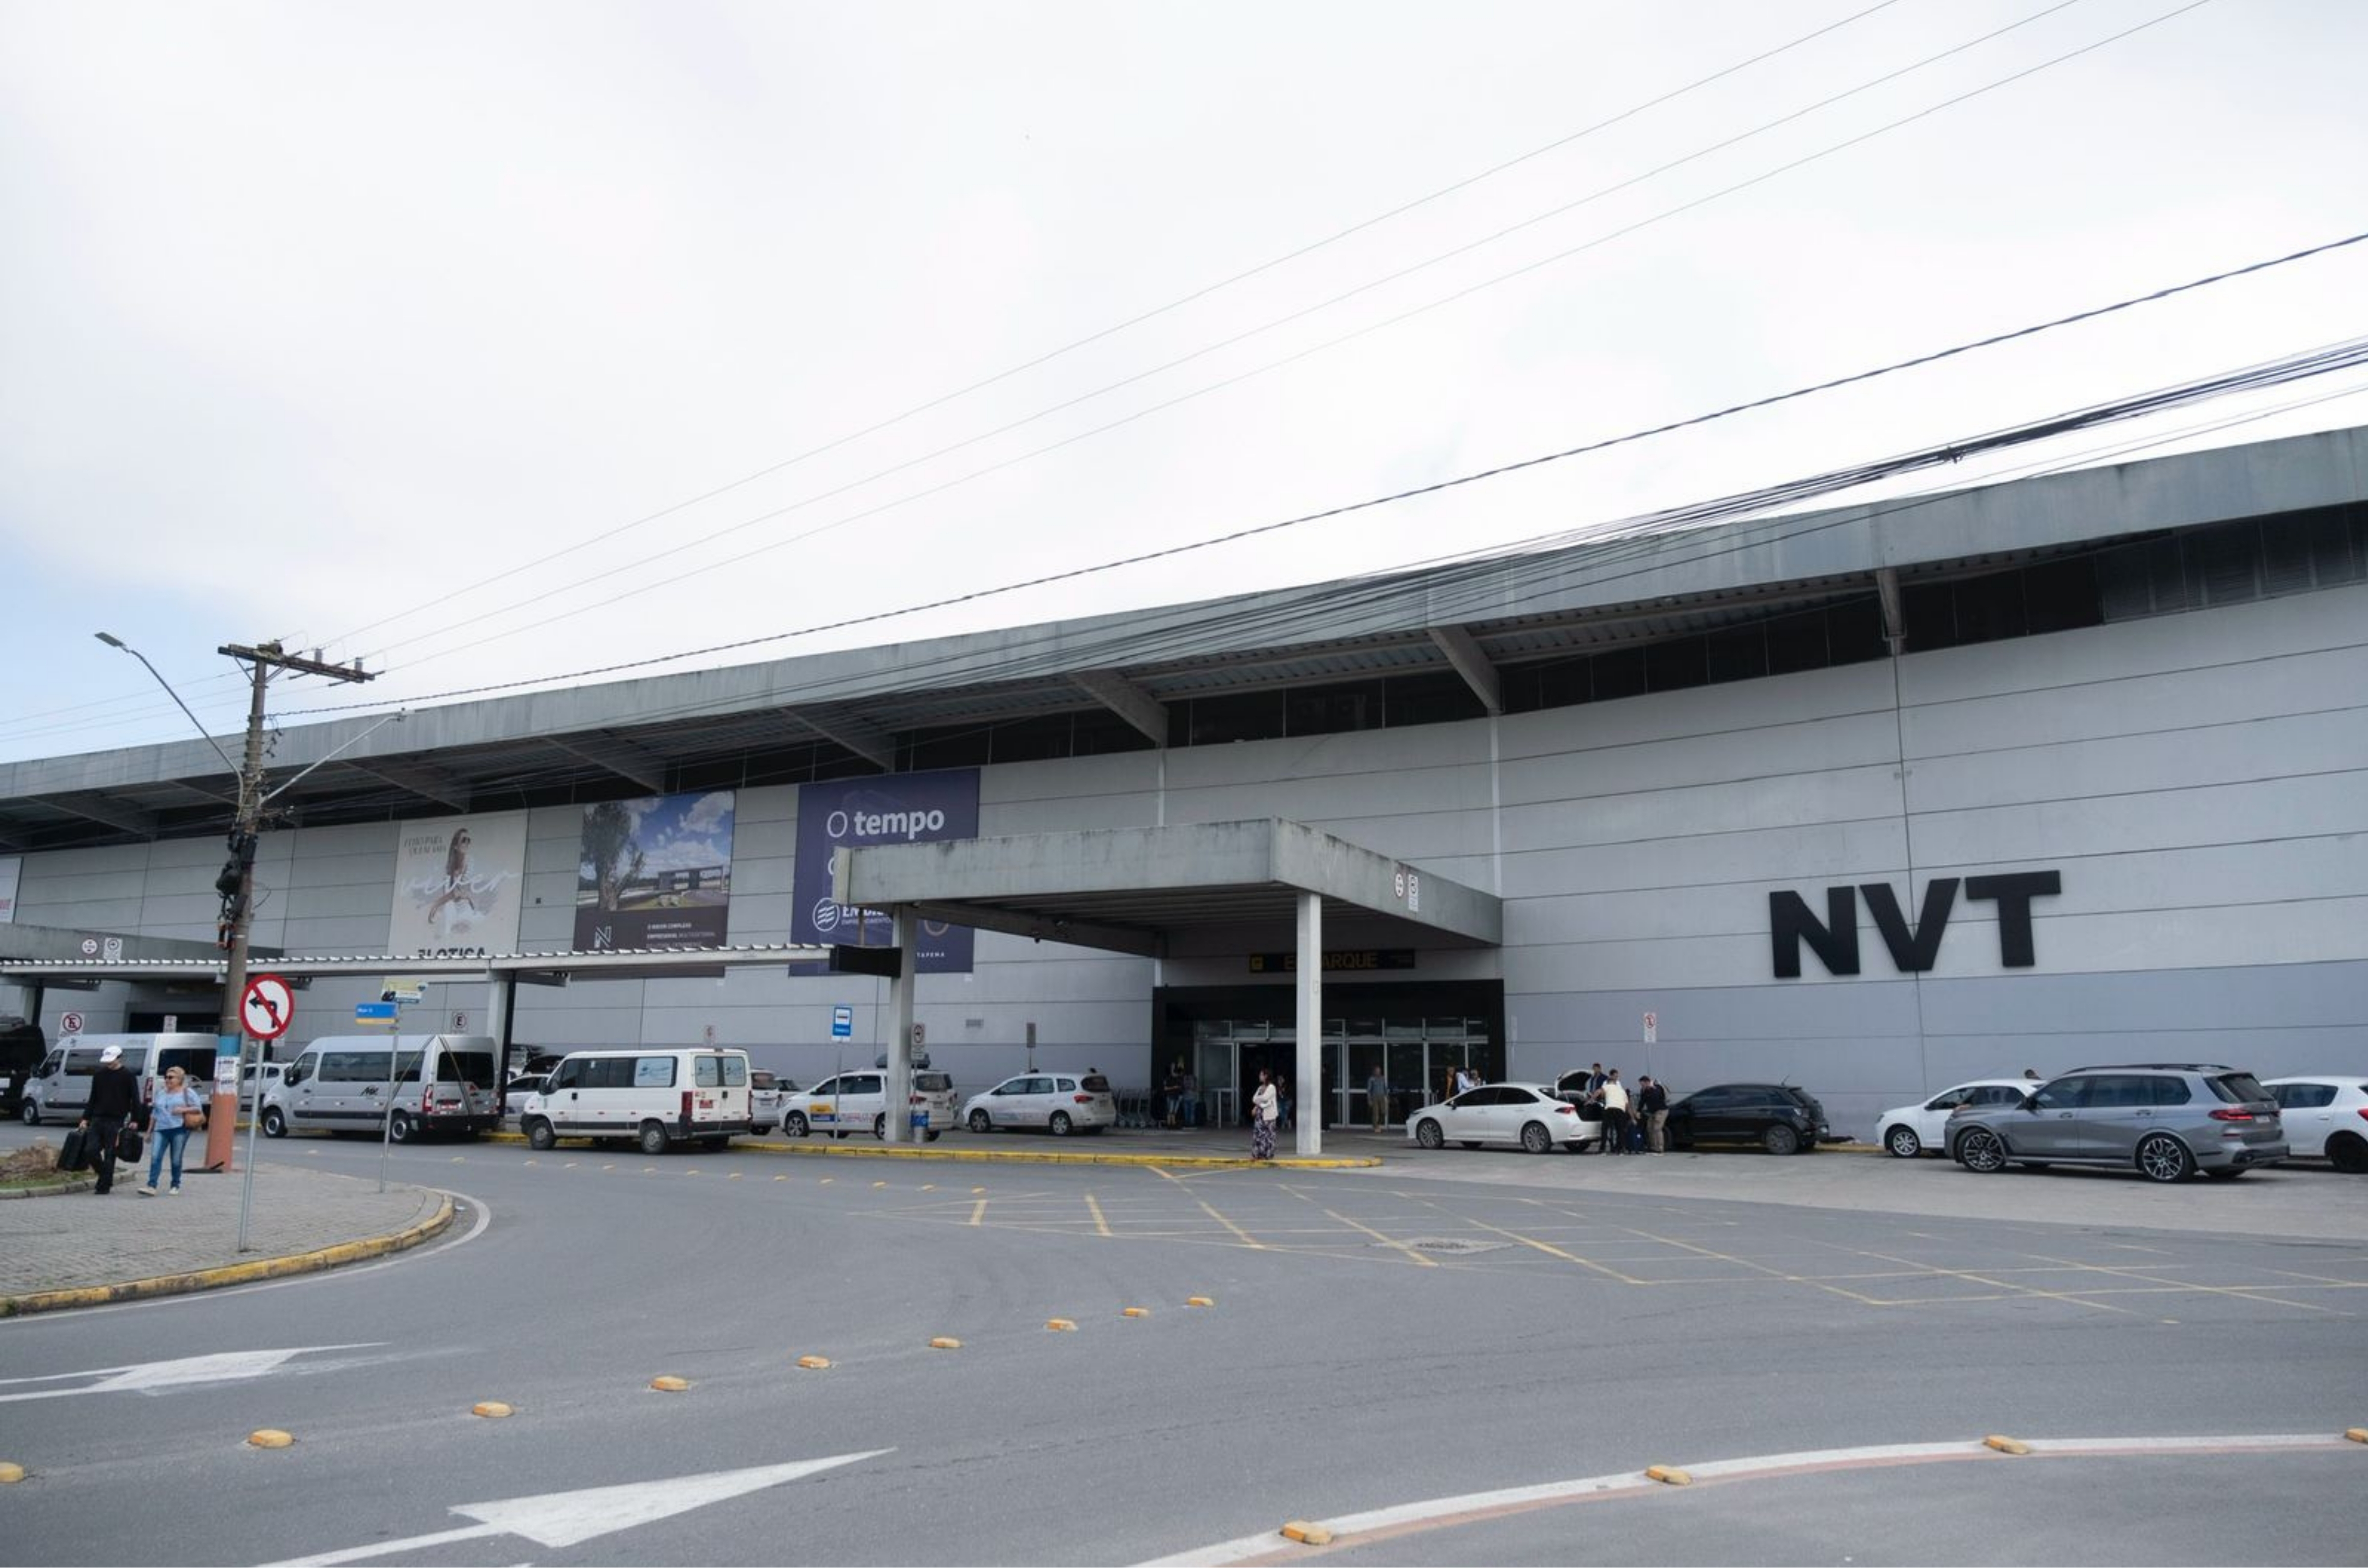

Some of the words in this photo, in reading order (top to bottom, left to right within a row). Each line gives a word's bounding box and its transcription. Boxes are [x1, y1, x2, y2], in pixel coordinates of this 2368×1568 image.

[854, 810, 945, 840] tempo
[1769, 870, 2061, 978] NVT
[1284, 952, 1378, 969] EARQUE
